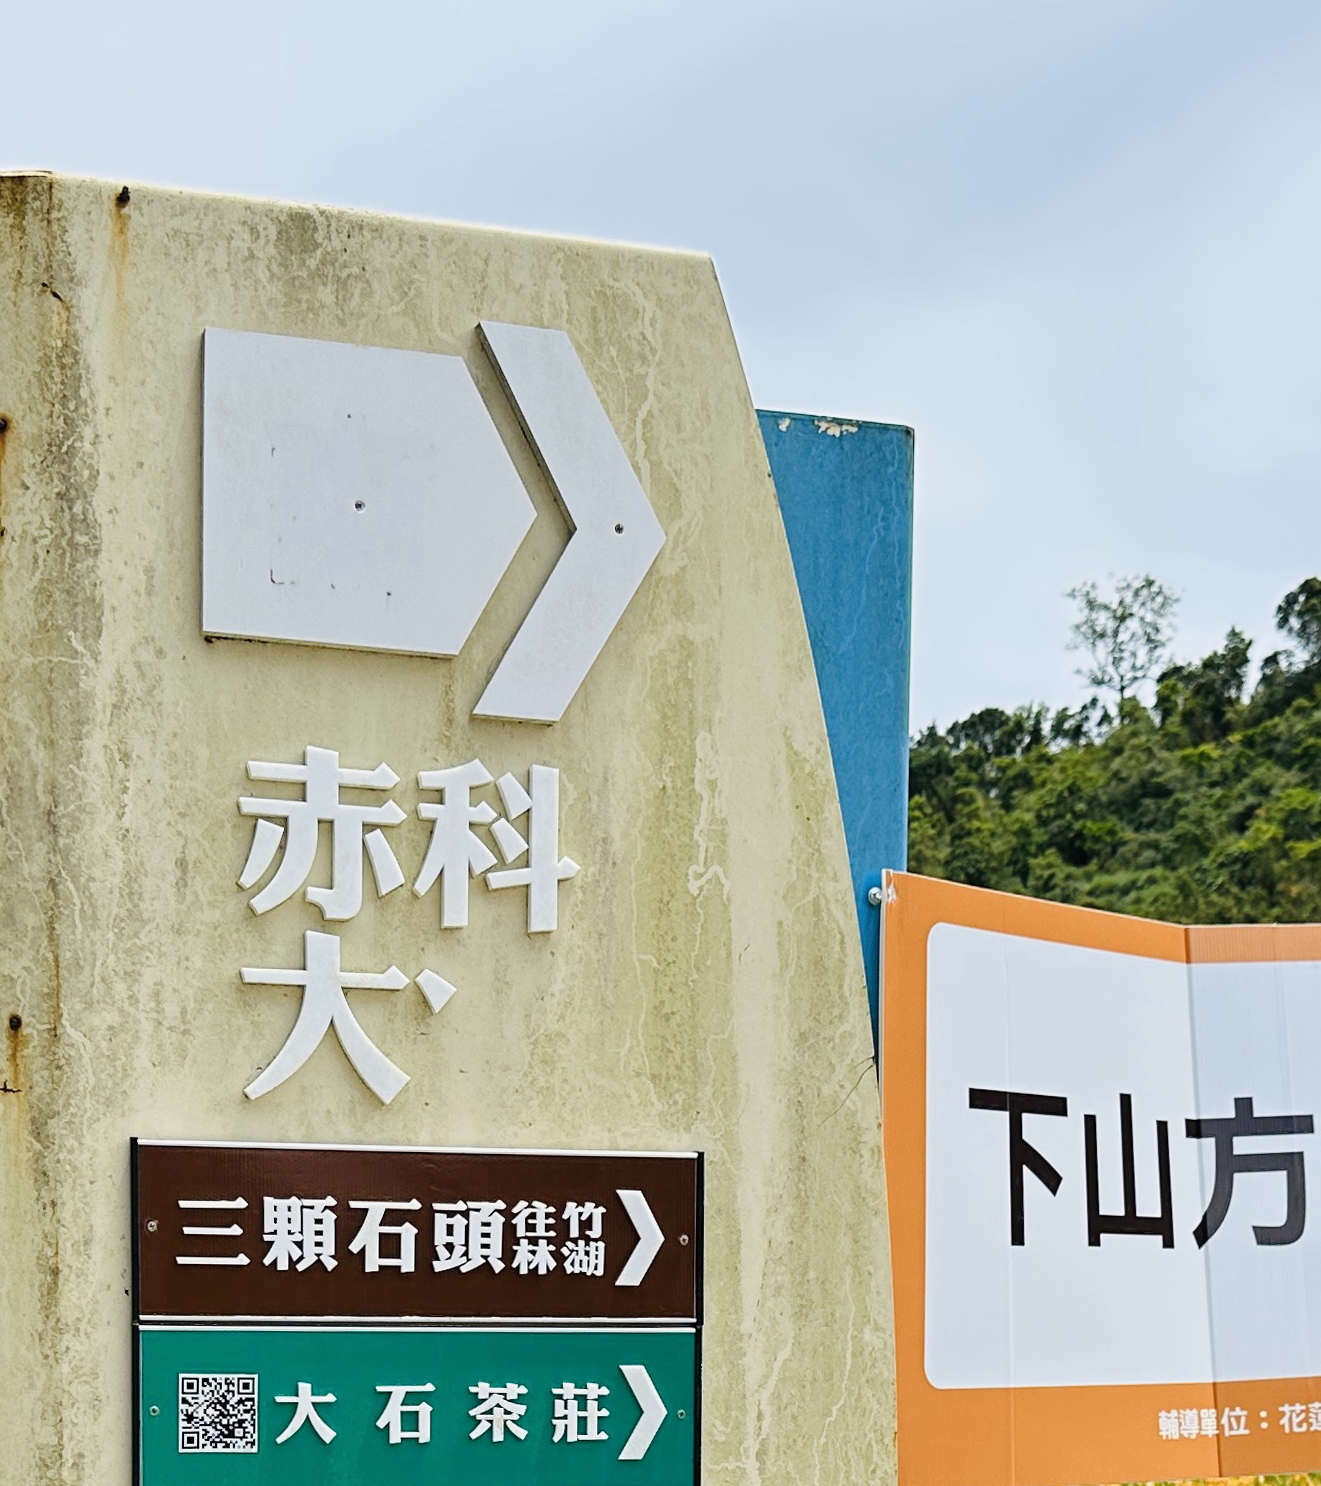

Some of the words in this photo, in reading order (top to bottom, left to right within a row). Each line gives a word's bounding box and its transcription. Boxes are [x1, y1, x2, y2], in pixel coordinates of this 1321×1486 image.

[237, 743, 582, 933] 赤科
[239, 929, 460, 1104] 大
[175, 1195, 507, 1274] 三顆石頭
[274, 1381, 610, 1444] 大石茶莊
